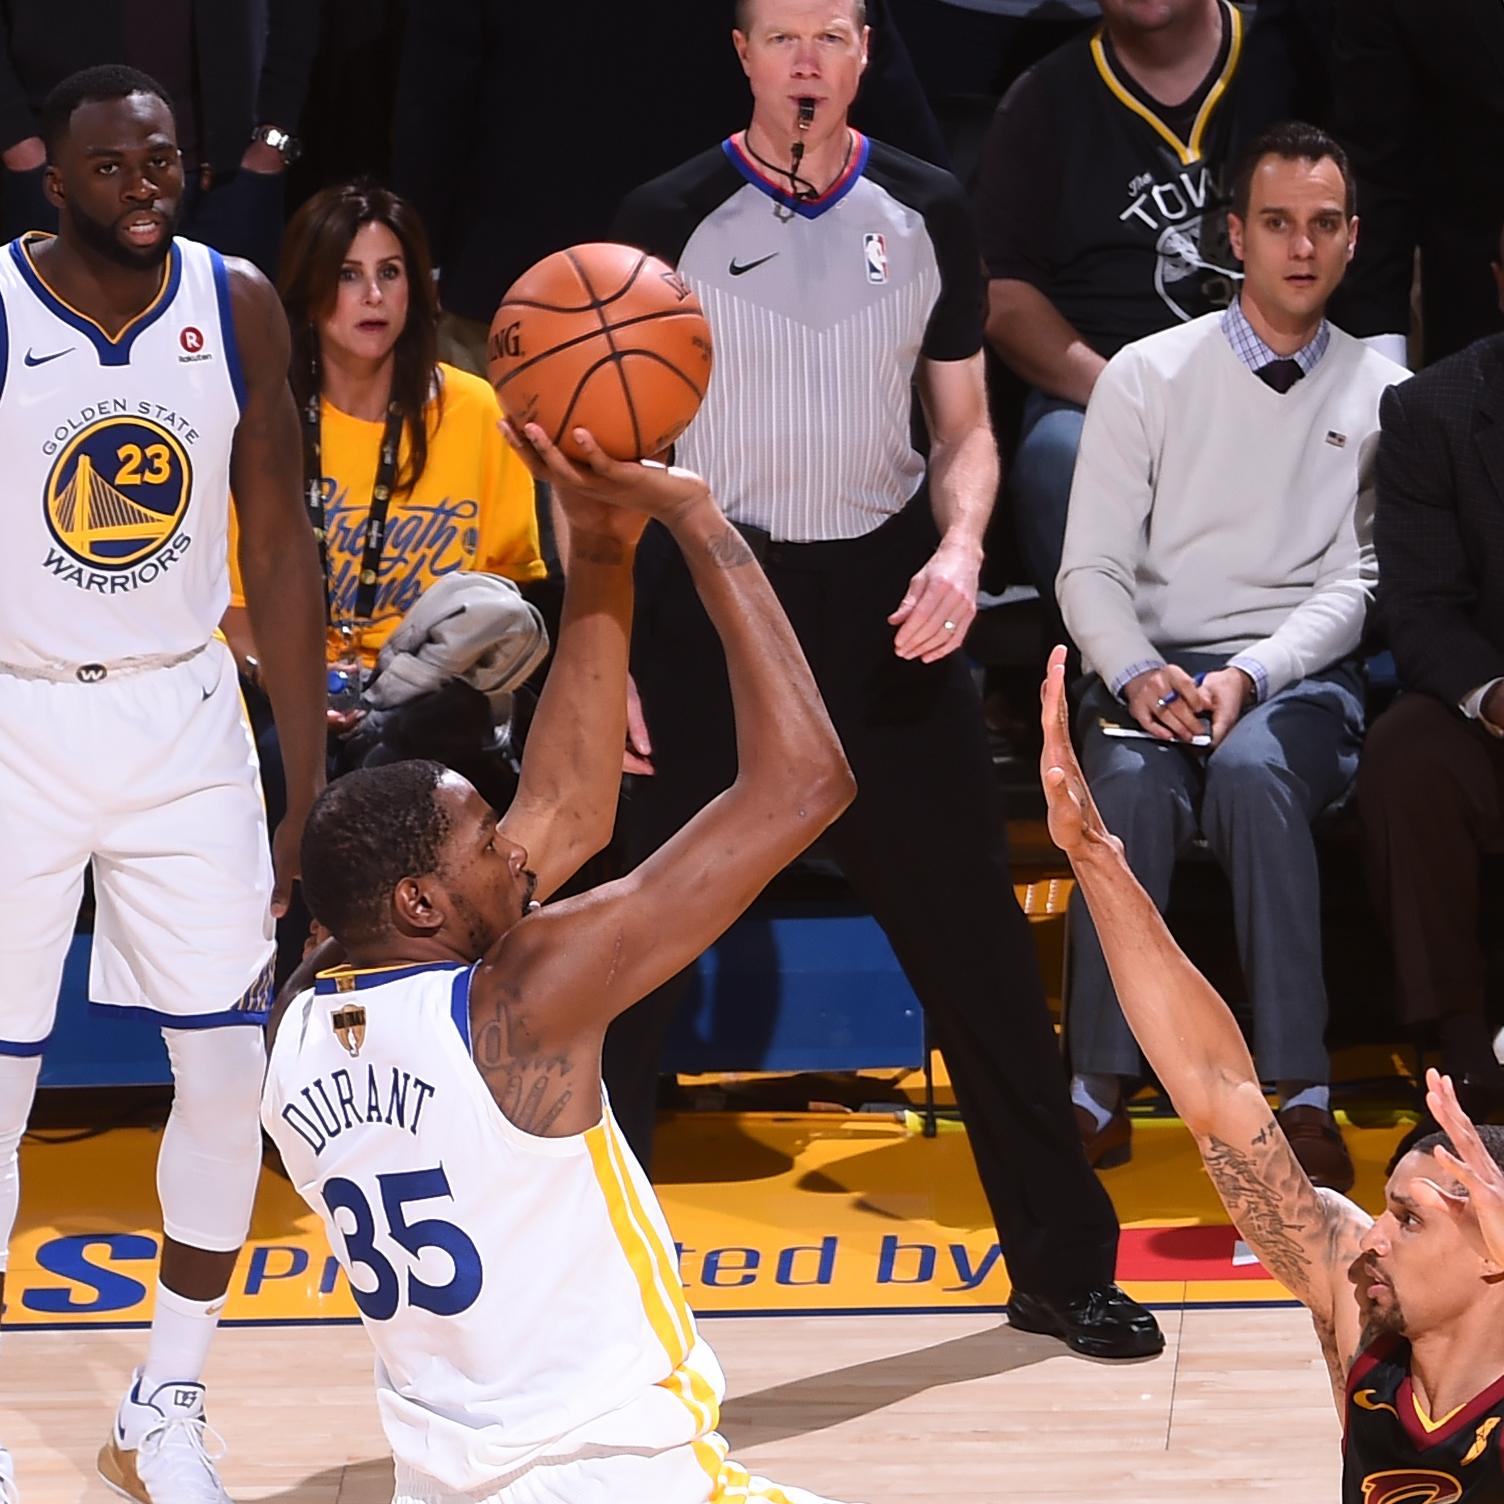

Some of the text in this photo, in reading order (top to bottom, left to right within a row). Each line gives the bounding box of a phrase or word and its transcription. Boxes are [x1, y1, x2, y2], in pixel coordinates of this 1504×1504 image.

[178, 354, 212, 363] Rakuten
[42, 398, 200, 456] GOLDEN STATE
[114, 443, 172, 485] 23
[42, 532, 192, 594] WARRIORS
[282, 1063, 436, 1156] DURANT
[321, 1160, 484, 1321] 35
[877, 1235, 1003, 1292] by
